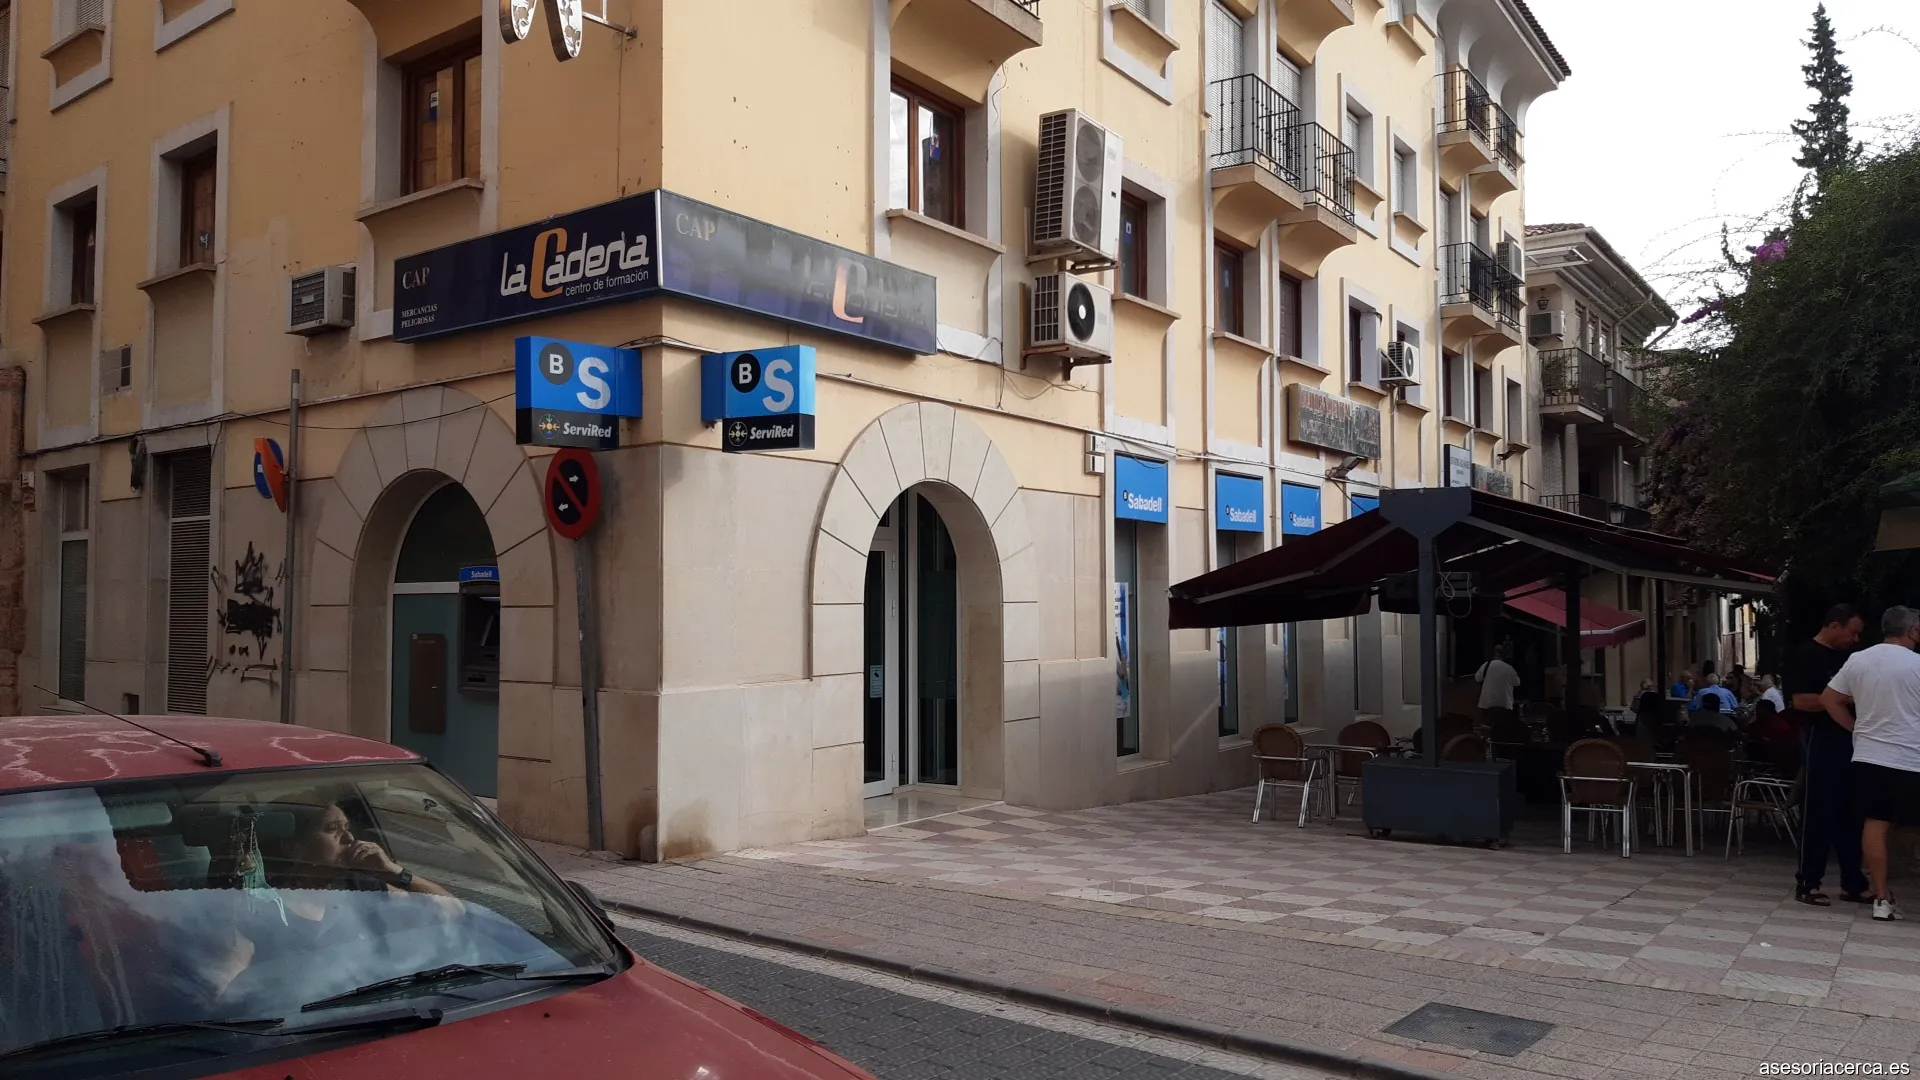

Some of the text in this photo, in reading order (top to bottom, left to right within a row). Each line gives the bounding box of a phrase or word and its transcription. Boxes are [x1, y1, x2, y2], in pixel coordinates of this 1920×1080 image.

[675, 212, 716, 241] CAP
[500, 252, 528, 297] la
[529, 227, 650, 299] Cadena
[402, 266, 430, 290] CAP
[565, 268, 649, 297] centro de formación
[400, 314, 435, 329] PELIGROSAS
[550, 353, 611, 410] B S
[738, 359, 795, 413] B S
[562, 421, 612, 439] ServiRed
[749, 424, 794, 440] ServiRed
[1128, 492, 1162, 513] Sabadell
[1229, 507, 1257, 523] Sabadell
[1292, 514, 1316, 529] Sabadell
[471, 570, 493, 578] Sabadell
